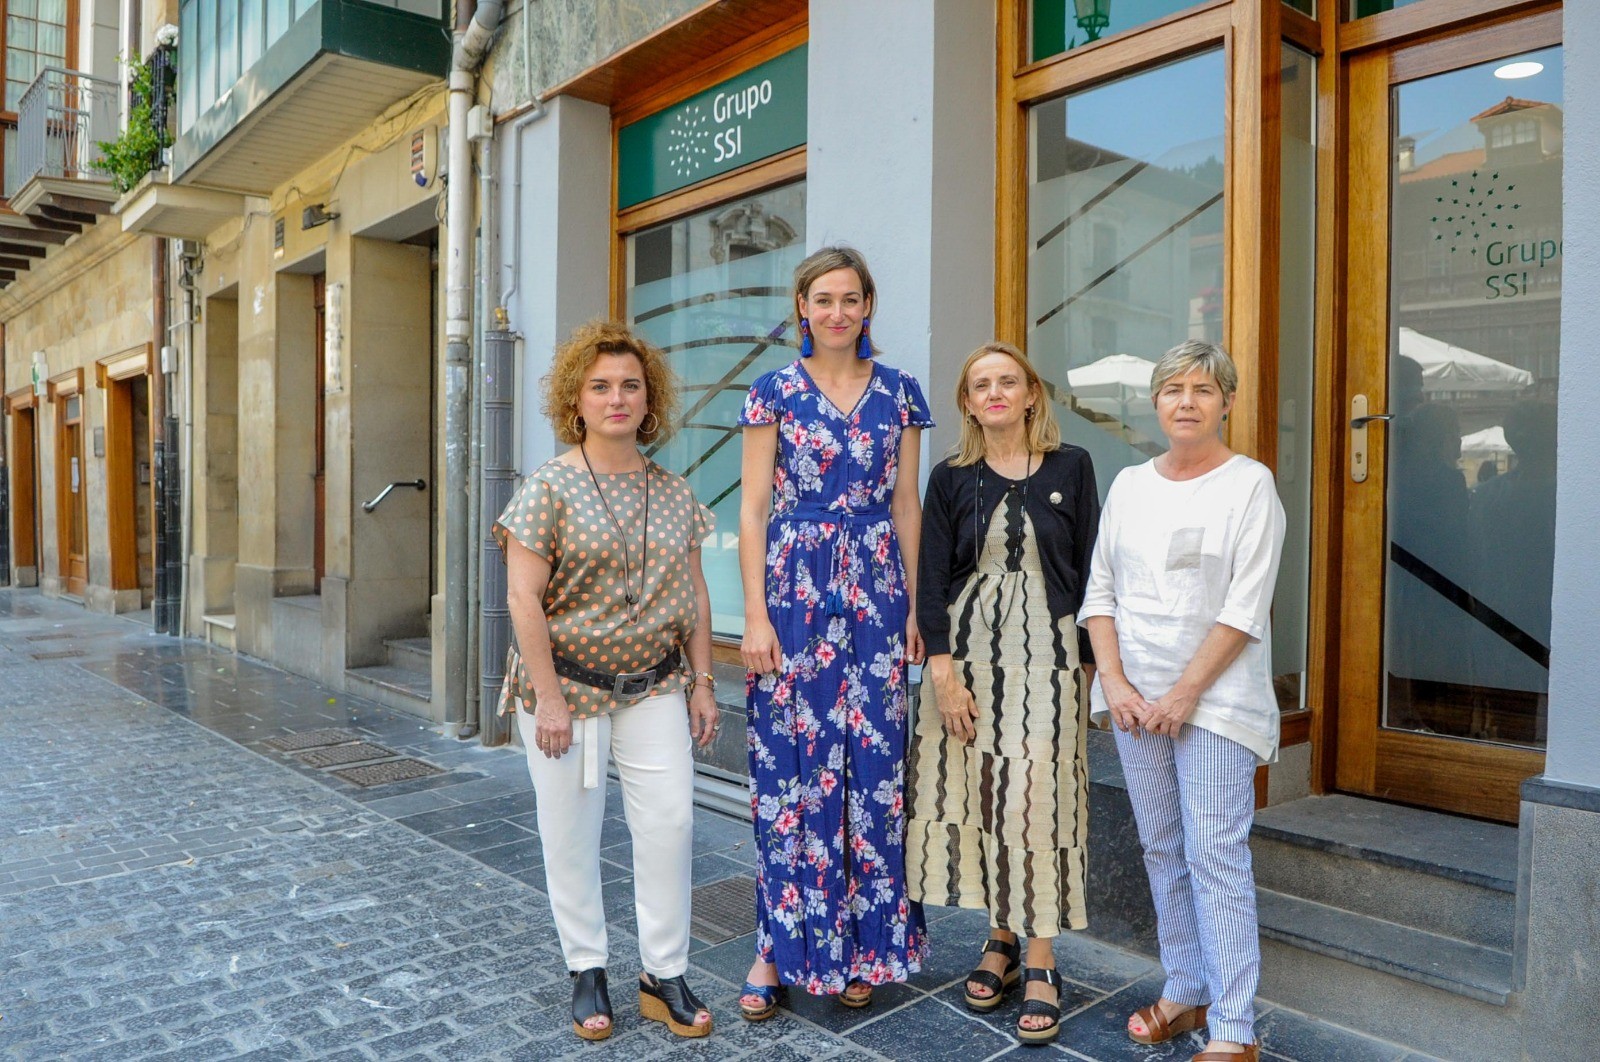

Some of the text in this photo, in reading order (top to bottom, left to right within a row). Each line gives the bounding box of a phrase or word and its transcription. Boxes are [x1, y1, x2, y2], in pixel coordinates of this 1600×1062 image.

[713, 79, 772, 124] Grupo
[713, 125, 742, 163] SSI
[1486, 240, 1562, 268] Grup
[1486, 271, 1527, 299] SSI
